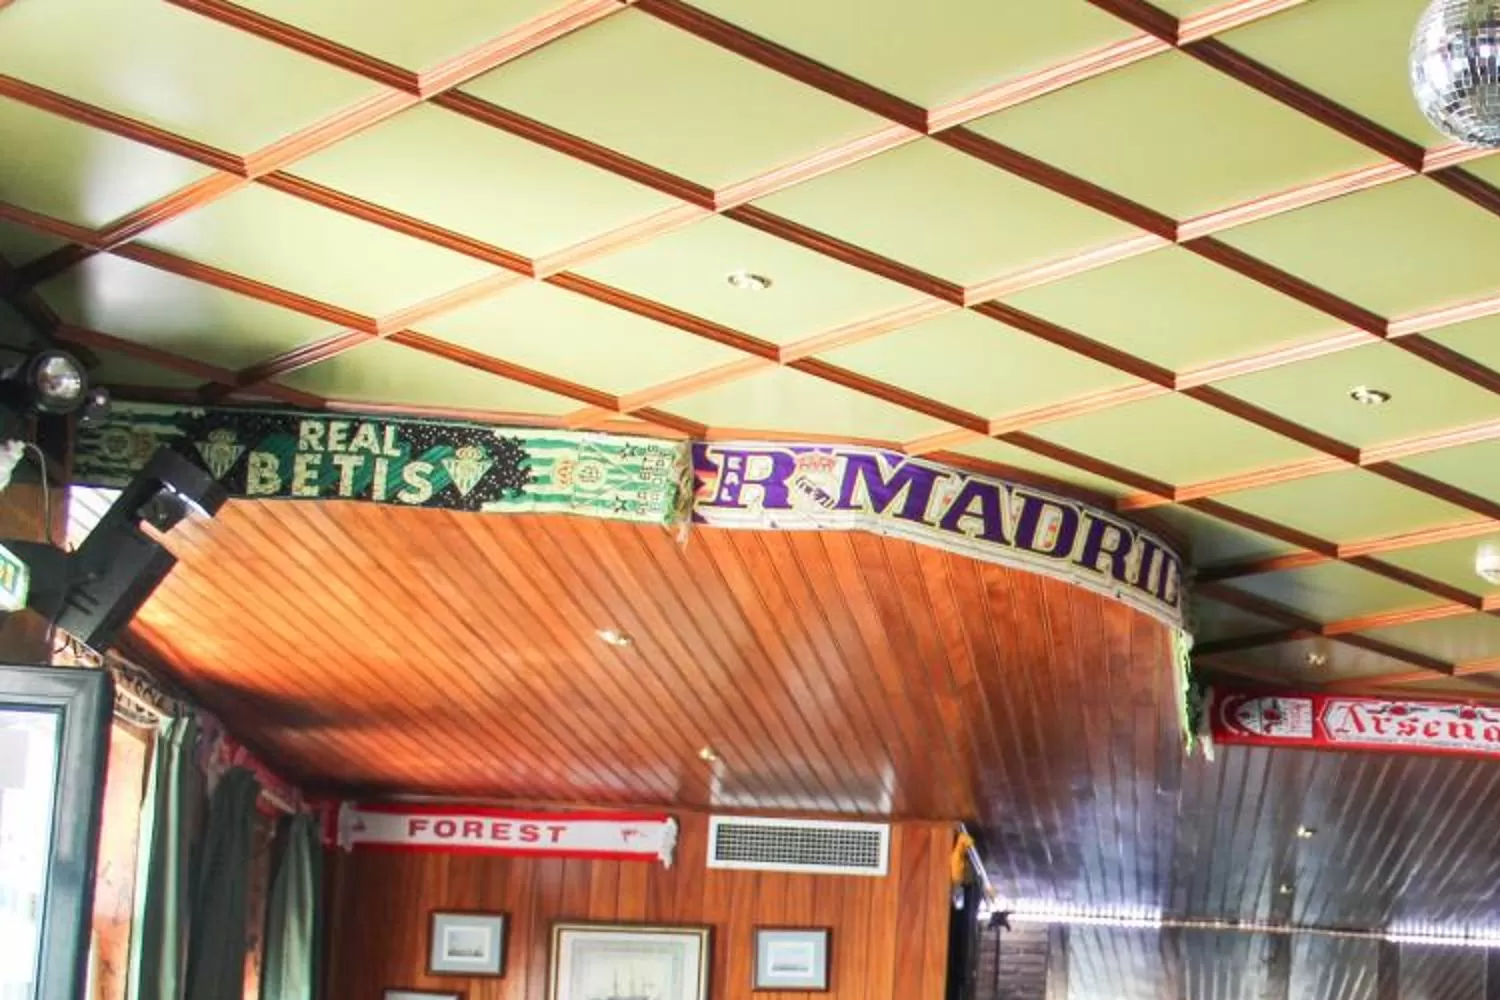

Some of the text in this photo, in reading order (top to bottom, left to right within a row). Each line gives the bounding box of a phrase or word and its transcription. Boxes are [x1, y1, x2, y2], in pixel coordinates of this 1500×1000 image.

[298, 419, 402, 458] REAL
[246, 453, 436, 506] BETIS
[835, 452, 1183, 610] MADRID
[407, 818, 568, 844] FOREST
